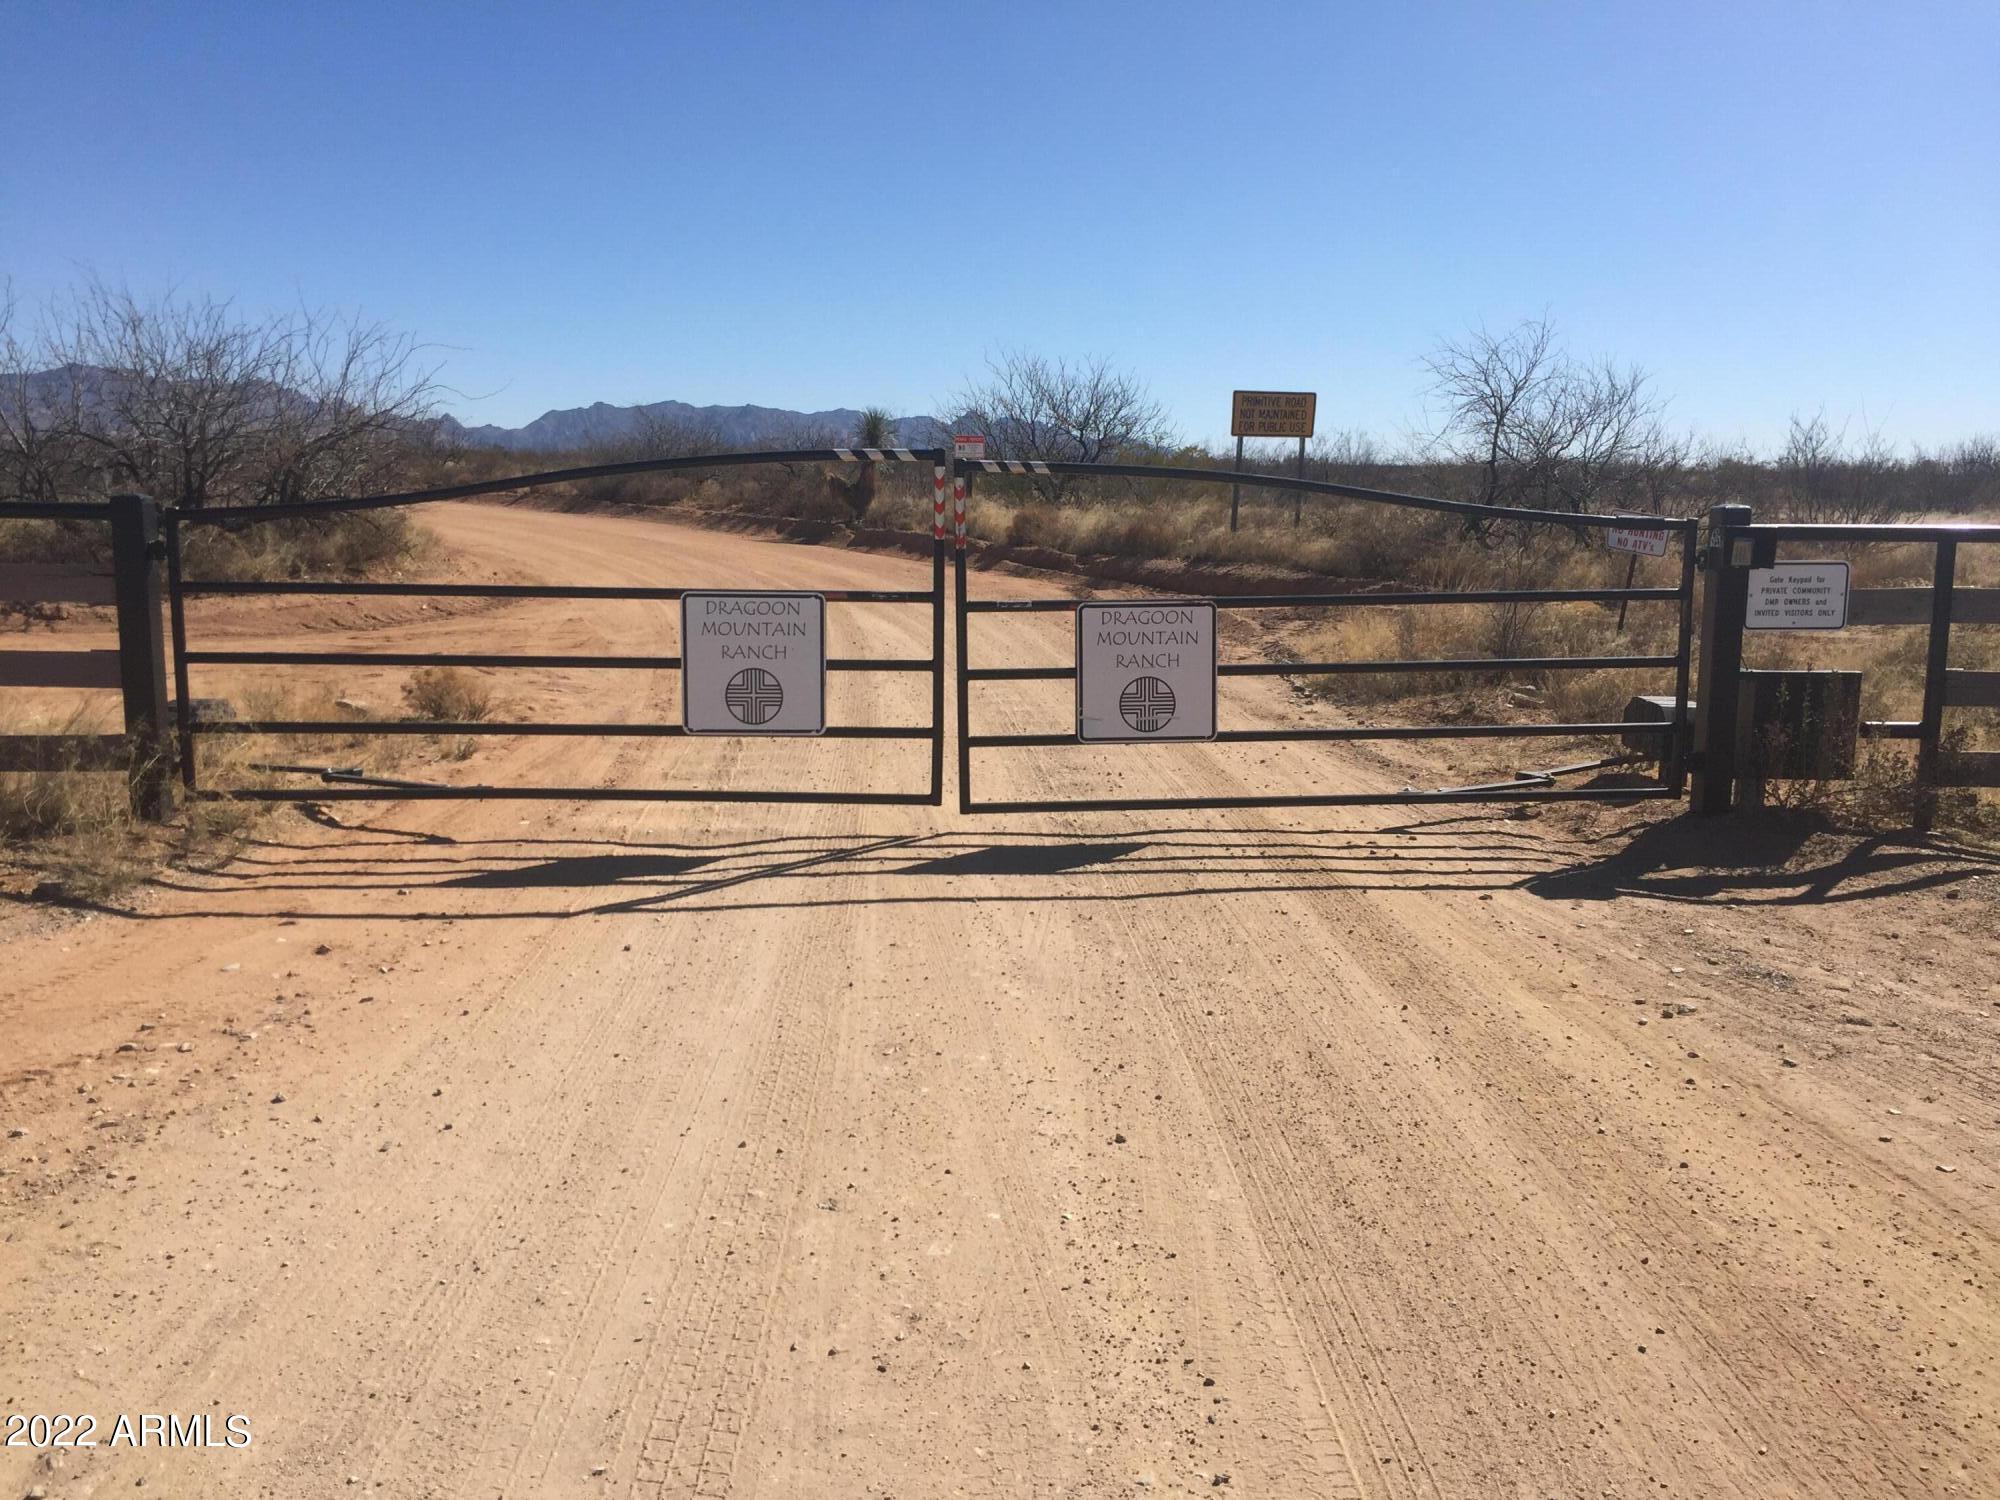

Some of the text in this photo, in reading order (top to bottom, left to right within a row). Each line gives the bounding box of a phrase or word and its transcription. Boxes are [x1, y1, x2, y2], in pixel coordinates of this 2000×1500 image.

[1241, 395, 1307, 408] PRIMITIVE ROAD
[1240, 408, 1307, 420] NOT MAINTAINED
[1239, 421, 1307, 433] FOR PUBLIC USE
[1616, 537, 1629, 547] NO
[1788, 576, 1812, 584] Keypad
[705, 600, 800, 616] DRAGOON
[1783, 598, 1811, 606] OWNERS
[1815, 598, 1827, 606] and
[1101, 610, 1193, 625] DRAGOON
[1754, 609, 1836, 617] INVITED VISITORS ONLY
[701, 621, 806, 637] MOUNTAIN
[1096, 630, 1199, 646] MOUNTAIN
[721, 644, 787, 660] RANCH
[1115, 653, 1180, 668] RANCH
